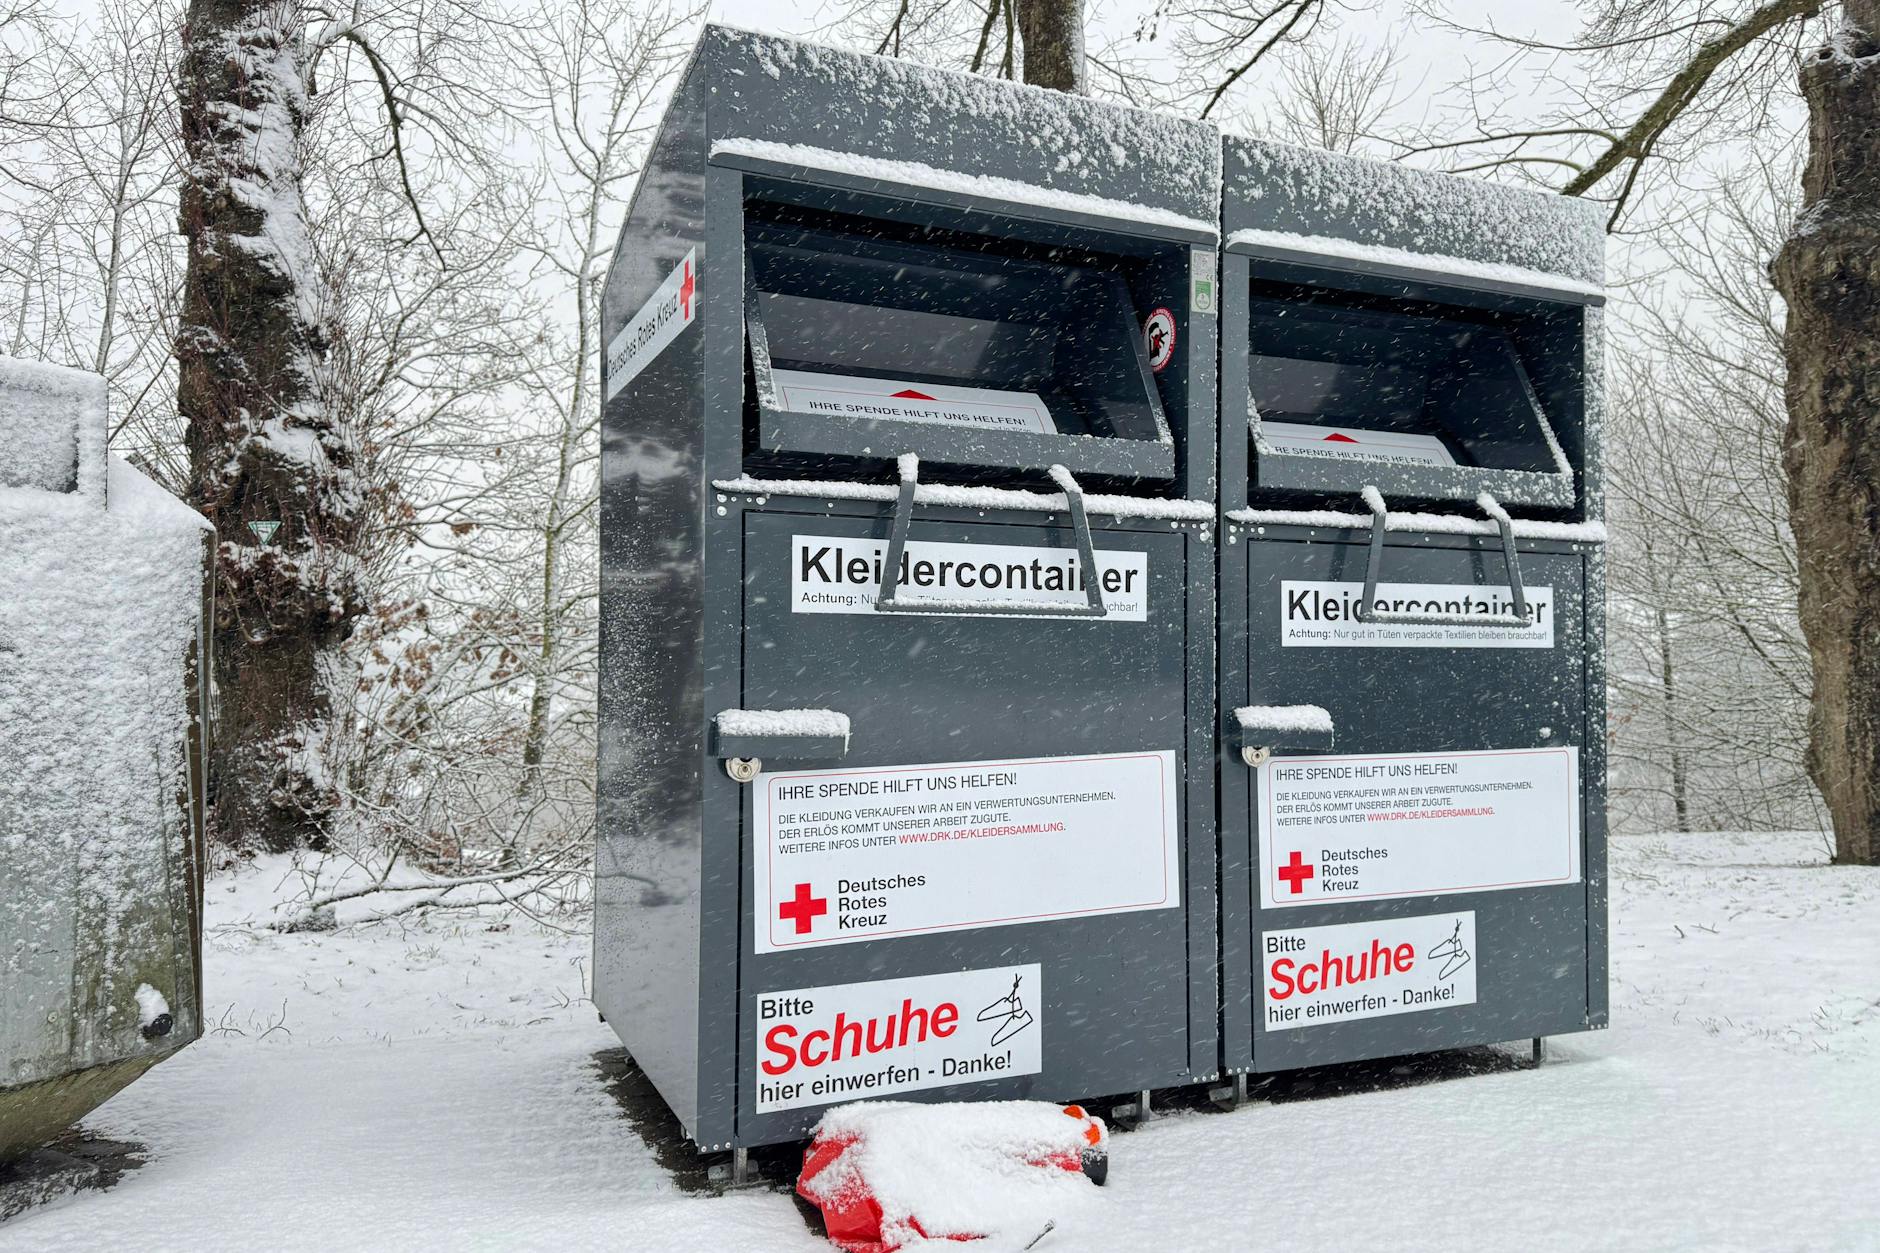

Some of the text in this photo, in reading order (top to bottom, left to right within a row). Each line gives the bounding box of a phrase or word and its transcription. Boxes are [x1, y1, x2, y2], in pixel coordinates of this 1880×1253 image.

[638, 317, 656, 351] Rotes
[657, 293, 678, 330] Kreuz
[809, 401, 842, 411] IHRE
[846, 404, 901, 416] SPENDE
[904, 409, 940, 419] HILFT
[943, 412, 970, 421] UNS
[973, 414, 1027, 426] HELFEN!
[1292, 447, 1336, 458] SPENDE
[801, 592, 857, 606] Achtung:
[1289, 628, 1547, 641] Achtung: Nur gut in Tüten verpackte Textilien bleiben brauchbar!
[1276, 763, 1458, 781] IHRE SPENDE HILFT UNS HELFEN!
[779, 773, 1017, 800] IHRE SPENDE HILFT UNS HELFEN!
[1277, 781, 1533, 801] DIE KLEIDUNG VERKAUFEN WIR AN EIN VERWERTUNGSUNTERNEHMEN.
[779, 791, 1117, 825] DIE KLEIDUNG VERKAUFEN WIR AN EIN VERWERTUNGSUNTERNEHMEN.
[1277, 797, 1453, 814] DER ERLÖS KOMMT UNSERER ARBEIT ZUGUTE.
[779, 813, 1012, 839] DER ERLÖS KOMMT UNSERER ARBEIT ZUGUTE.
[1277, 817, 1313, 827] WEITERE
[1314, 815, 1338, 825] INFOS
[1340, 813, 1366, 823] UNTER
[779, 822, 1066, 854] WEITERE INFOS UNTER WWW.DRK.DE/KLEIDERSAMMLUNG.
[1321, 847, 1389, 862] Deutsches
[1322, 863, 1359, 877] Rotes
[838, 873, 927, 895] Deutsches
[1322, 879, 1360, 892] Kreuz
[838, 895, 887, 912] Rotes
[838, 913, 888, 930] Kreuz
[1267, 935, 1306, 953] Bitte
[1269, 938, 1415, 1000] Schuhe
[761, 997, 814, 1020] Bitte
[1269, 1005, 1301, 1023] hier
[1306, 994, 1387, 1018] einwerfen
[1403, 984, 1455, 1005] Danke!
[761, 998, 959, 1076] Schuhe
[760, 1081, 805, 1103] hier
[811, 1065, 920, 1095] einwerfen
[942, 1050, 1012, 1077] Danke!
